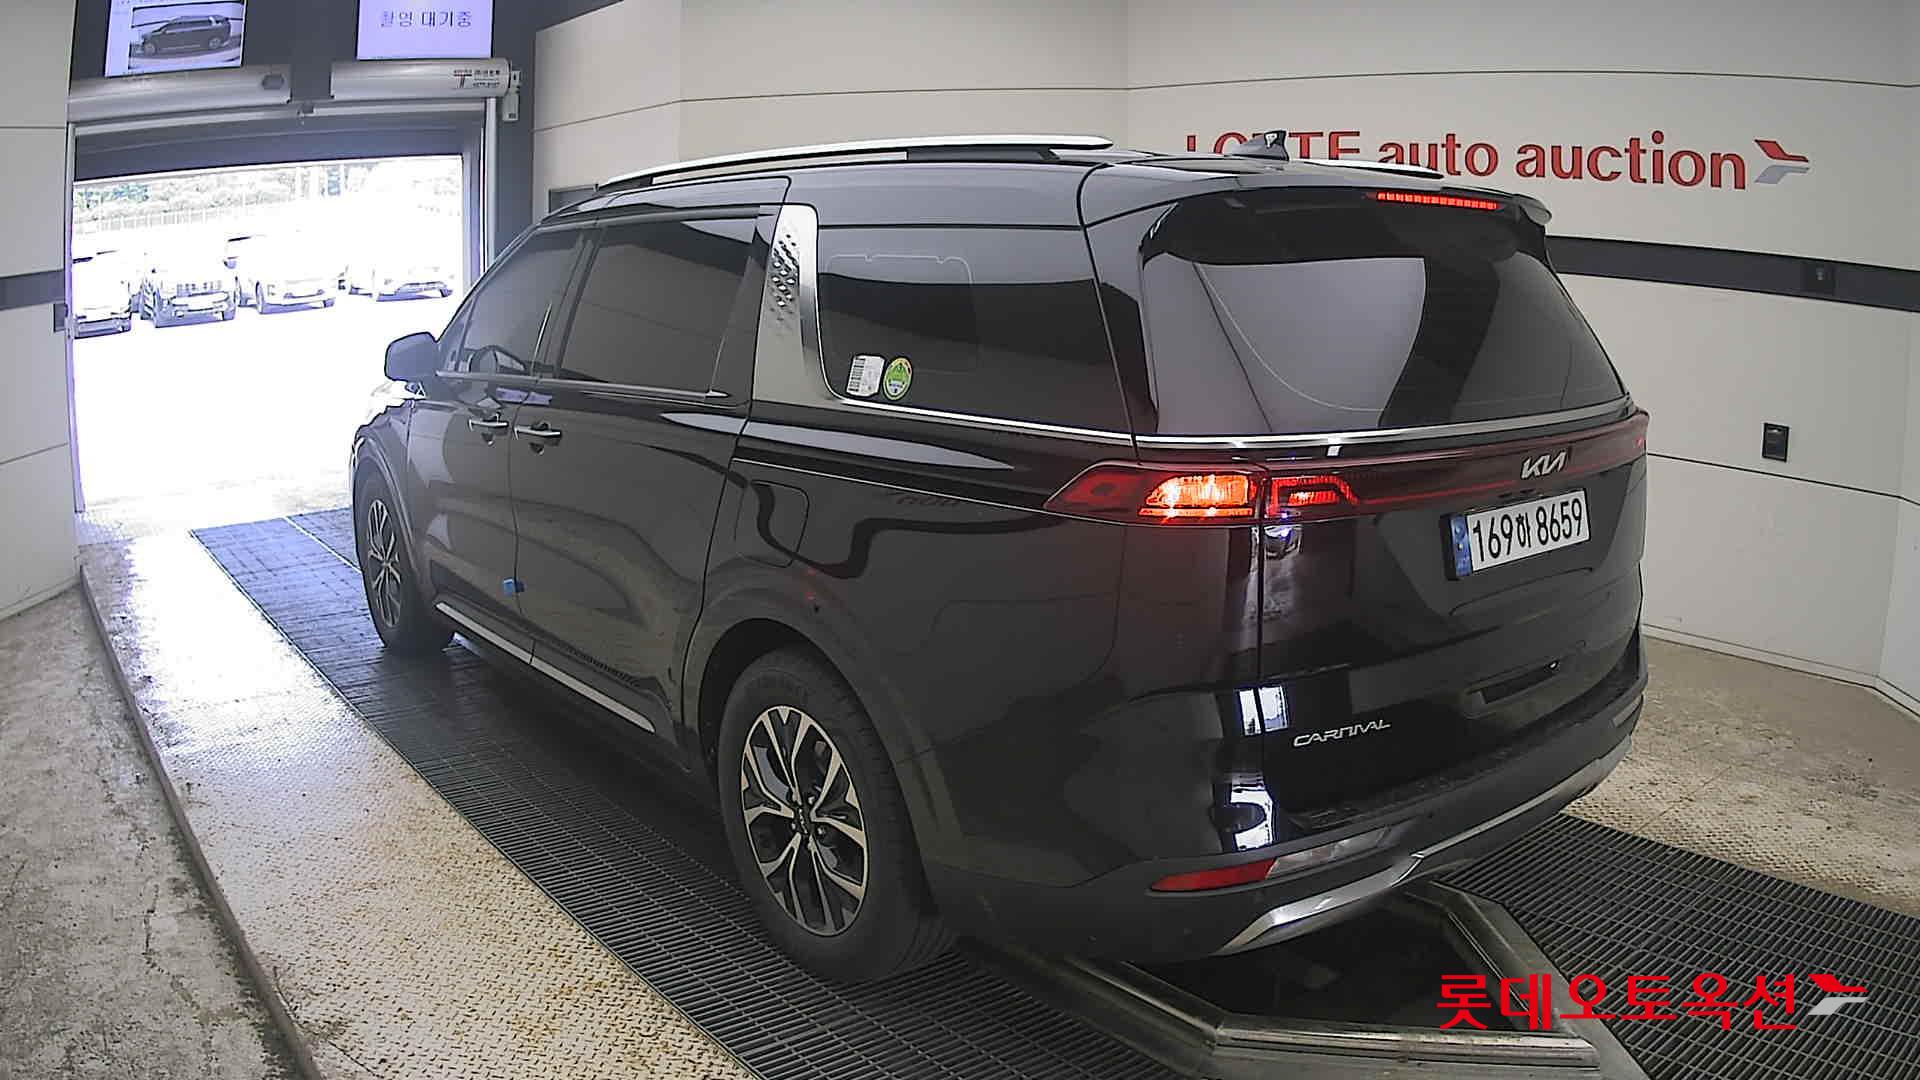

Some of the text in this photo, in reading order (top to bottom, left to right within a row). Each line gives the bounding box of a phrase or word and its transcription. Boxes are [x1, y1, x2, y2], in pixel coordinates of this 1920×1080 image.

[421, 10, 473, 28] 대기중
[1378, 133, 1499, 177] auto
[1515, 130, 1746, 190] auction
[1472, 498, 1583, 562] 169하 8659
[1293, 719, 1391, 747] CARNIVAL
